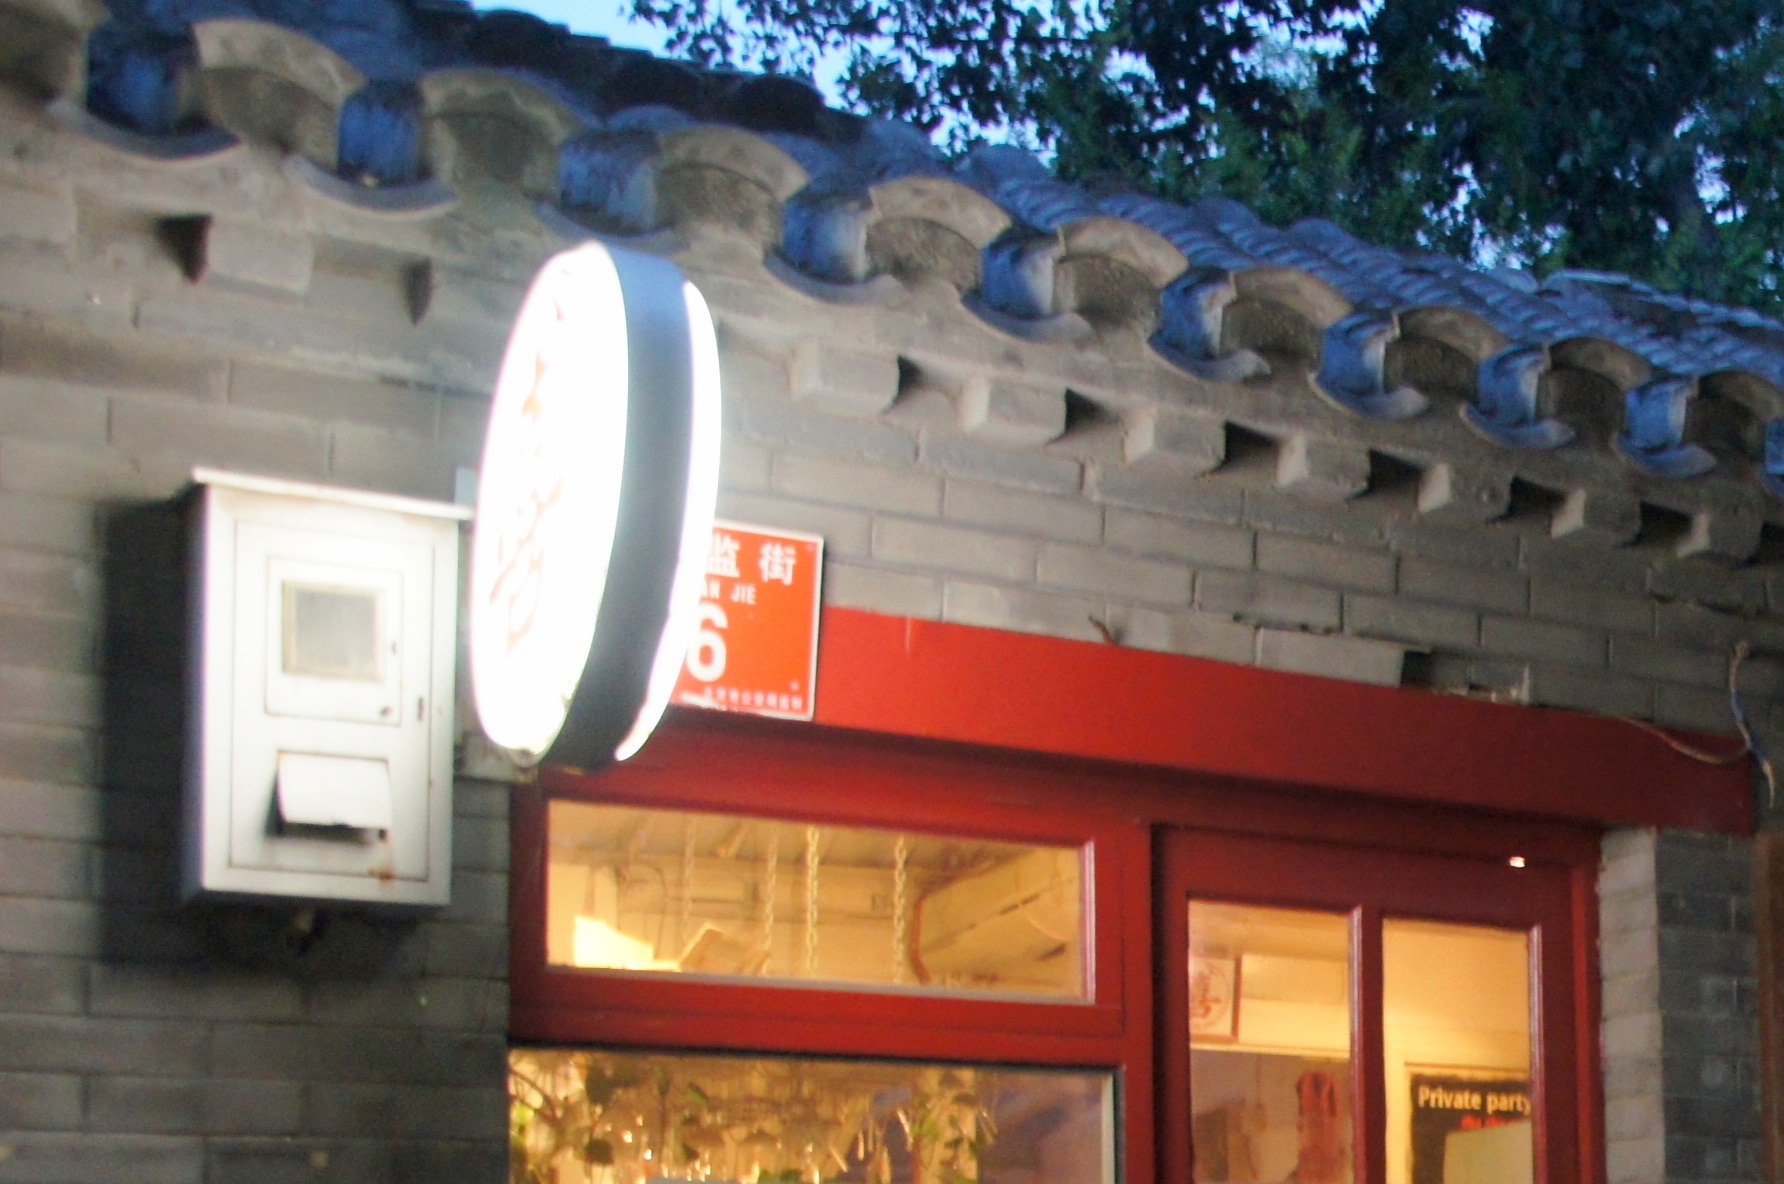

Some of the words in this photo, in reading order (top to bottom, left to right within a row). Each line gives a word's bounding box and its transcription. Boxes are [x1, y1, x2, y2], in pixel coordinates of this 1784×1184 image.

[731, 582, 756, 605] JIE
[1418, 1084, 1482, 1110] Private
[1486, 1091, 1532, 1115] party
